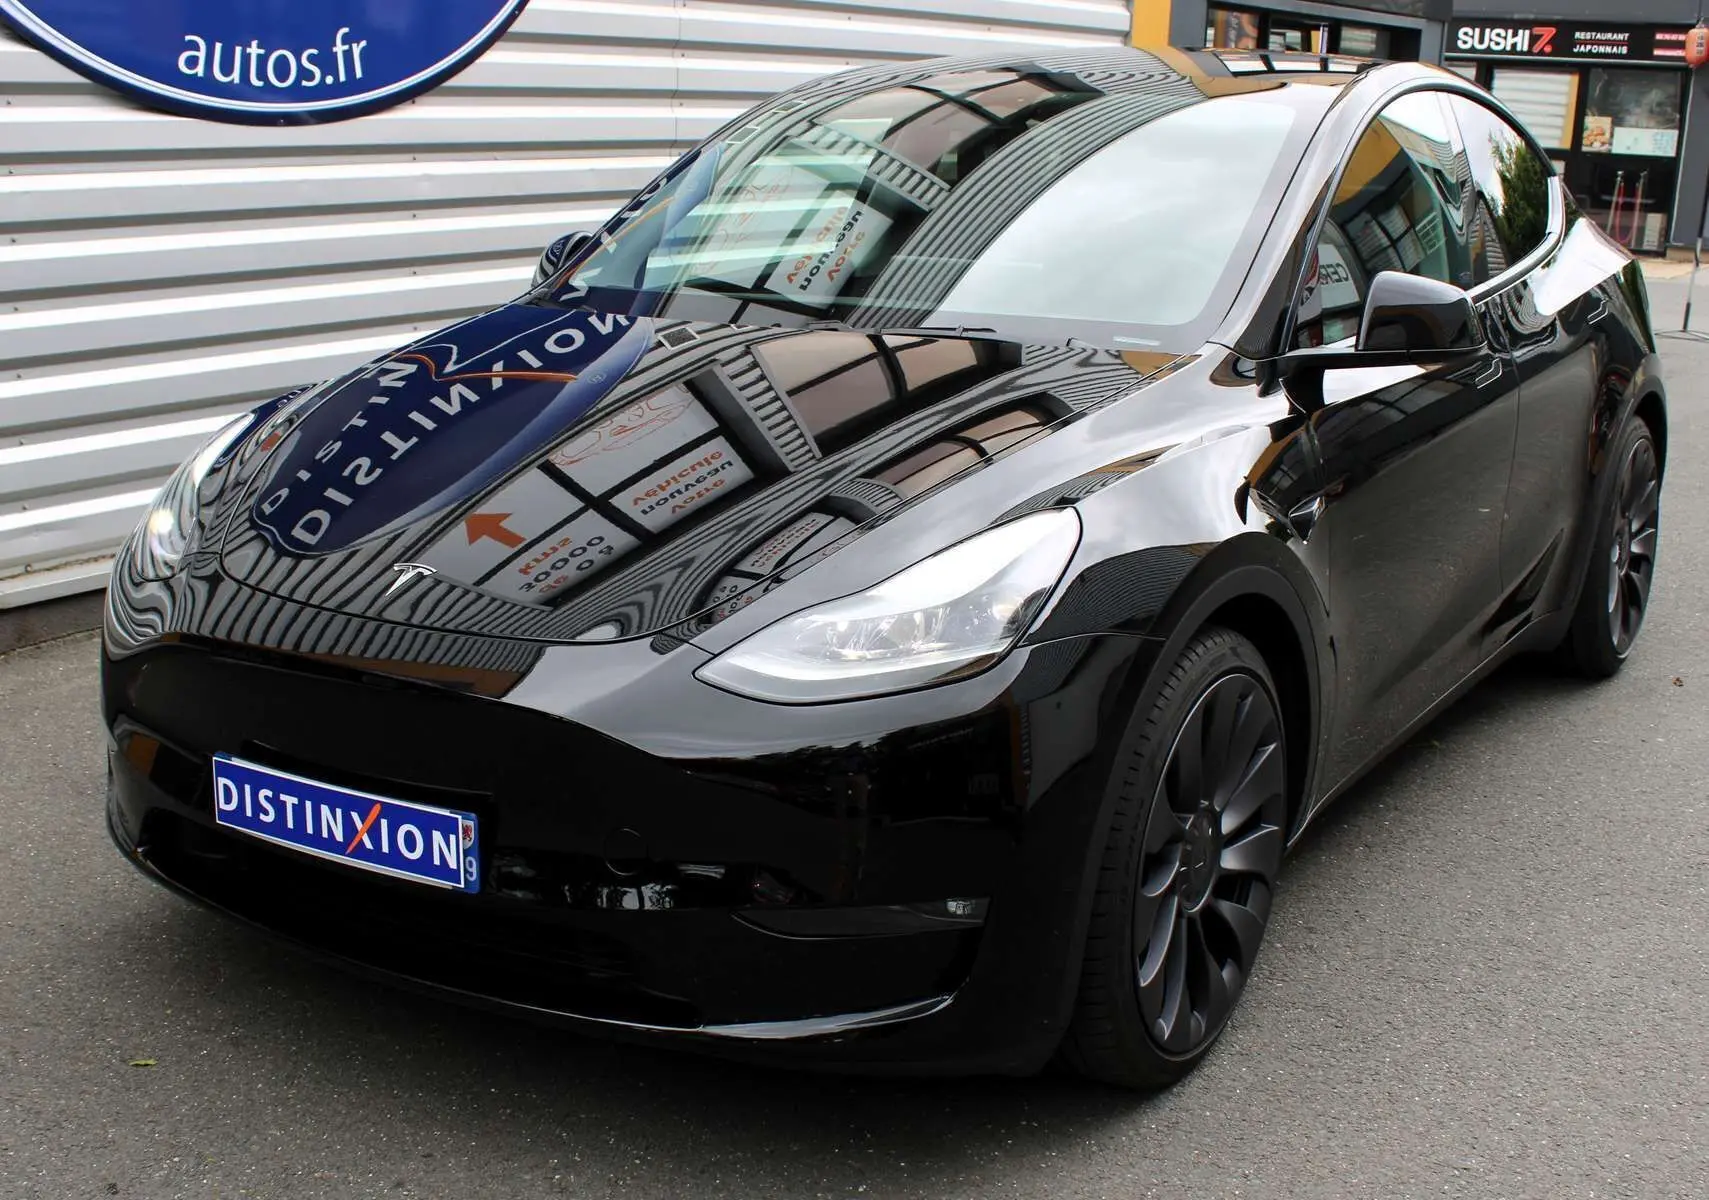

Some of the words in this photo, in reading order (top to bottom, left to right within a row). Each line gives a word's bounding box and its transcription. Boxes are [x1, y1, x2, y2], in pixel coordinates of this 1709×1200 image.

[1573, 45, 1628, 54] JAPONNAIS
[1574, 31, 1630, 41] RESTAURANT
[177, 27, 367, 88] autos.fr
[216, 776, 458, 870] DISTINXION
